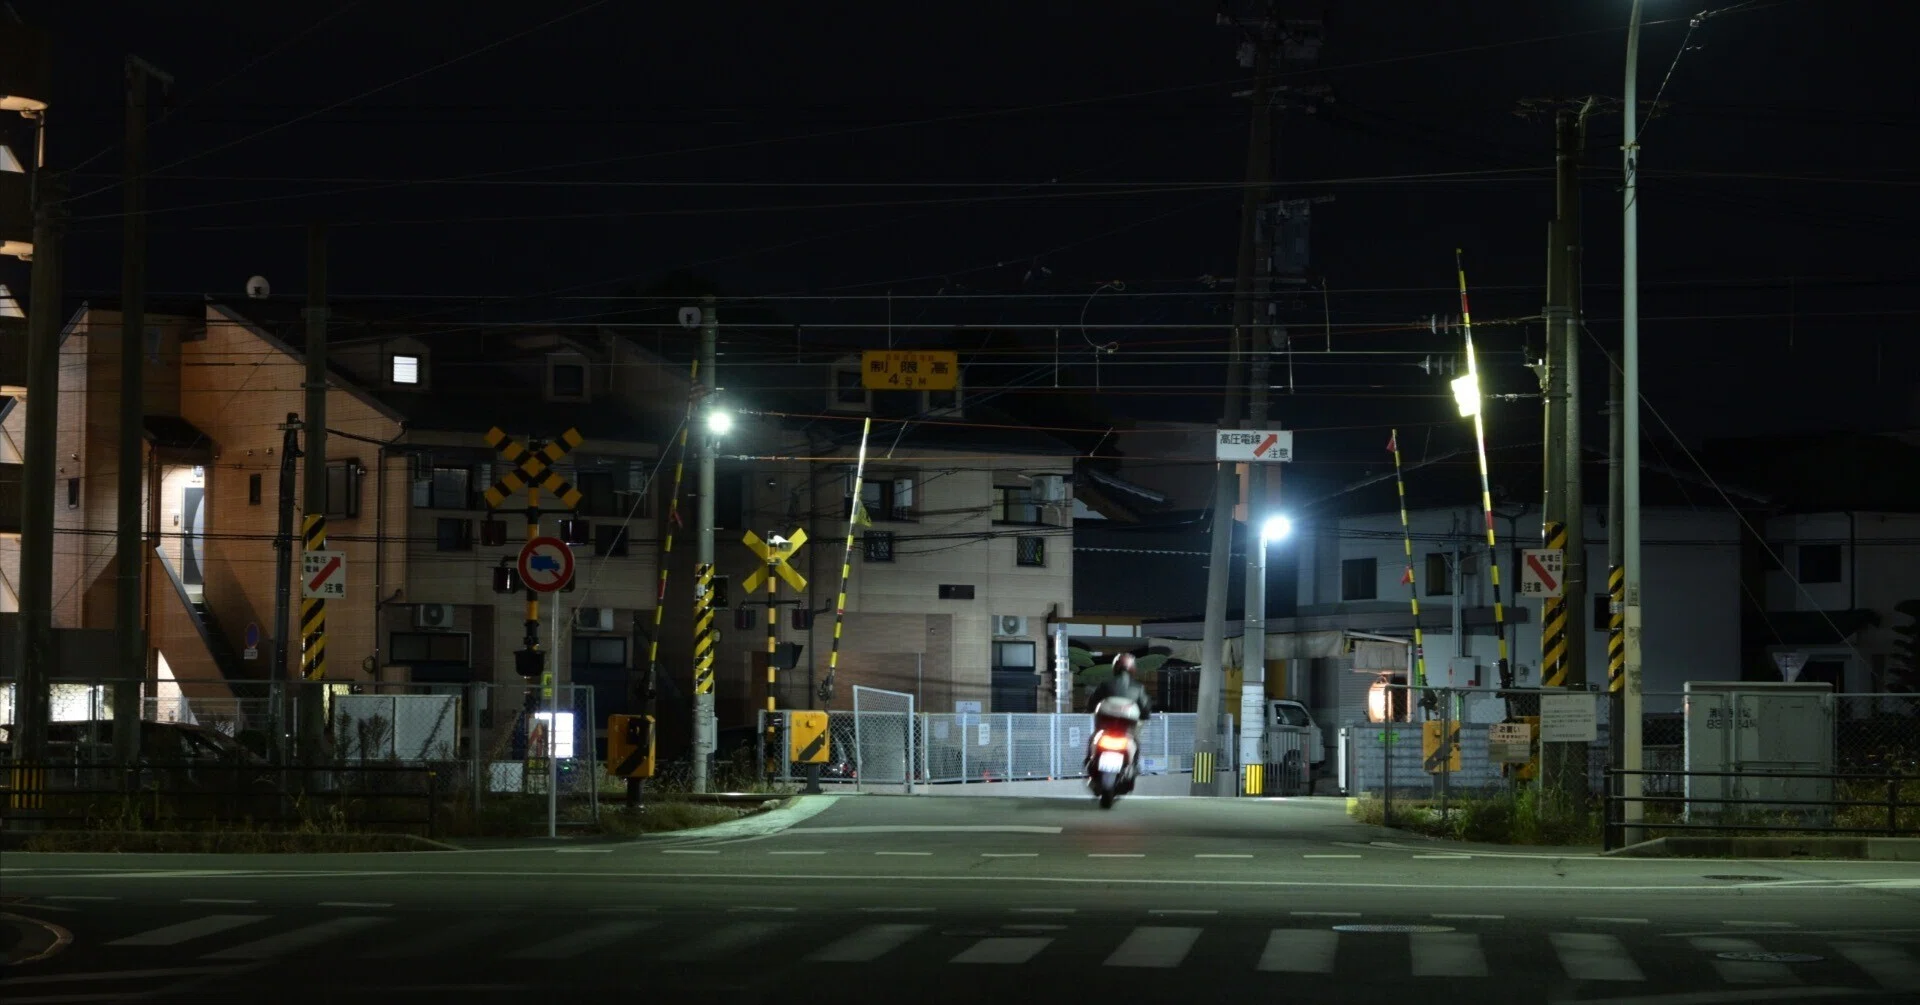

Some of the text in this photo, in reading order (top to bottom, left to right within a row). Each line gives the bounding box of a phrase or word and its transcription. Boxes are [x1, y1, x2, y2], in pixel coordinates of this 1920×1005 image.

[1220, 433, 1261, 444] 高圧電線
[1268, 448, 1289, 459] 注意
[325, 583, 343, 593] 注意
[1523, 582, 1541, 592] 注意
